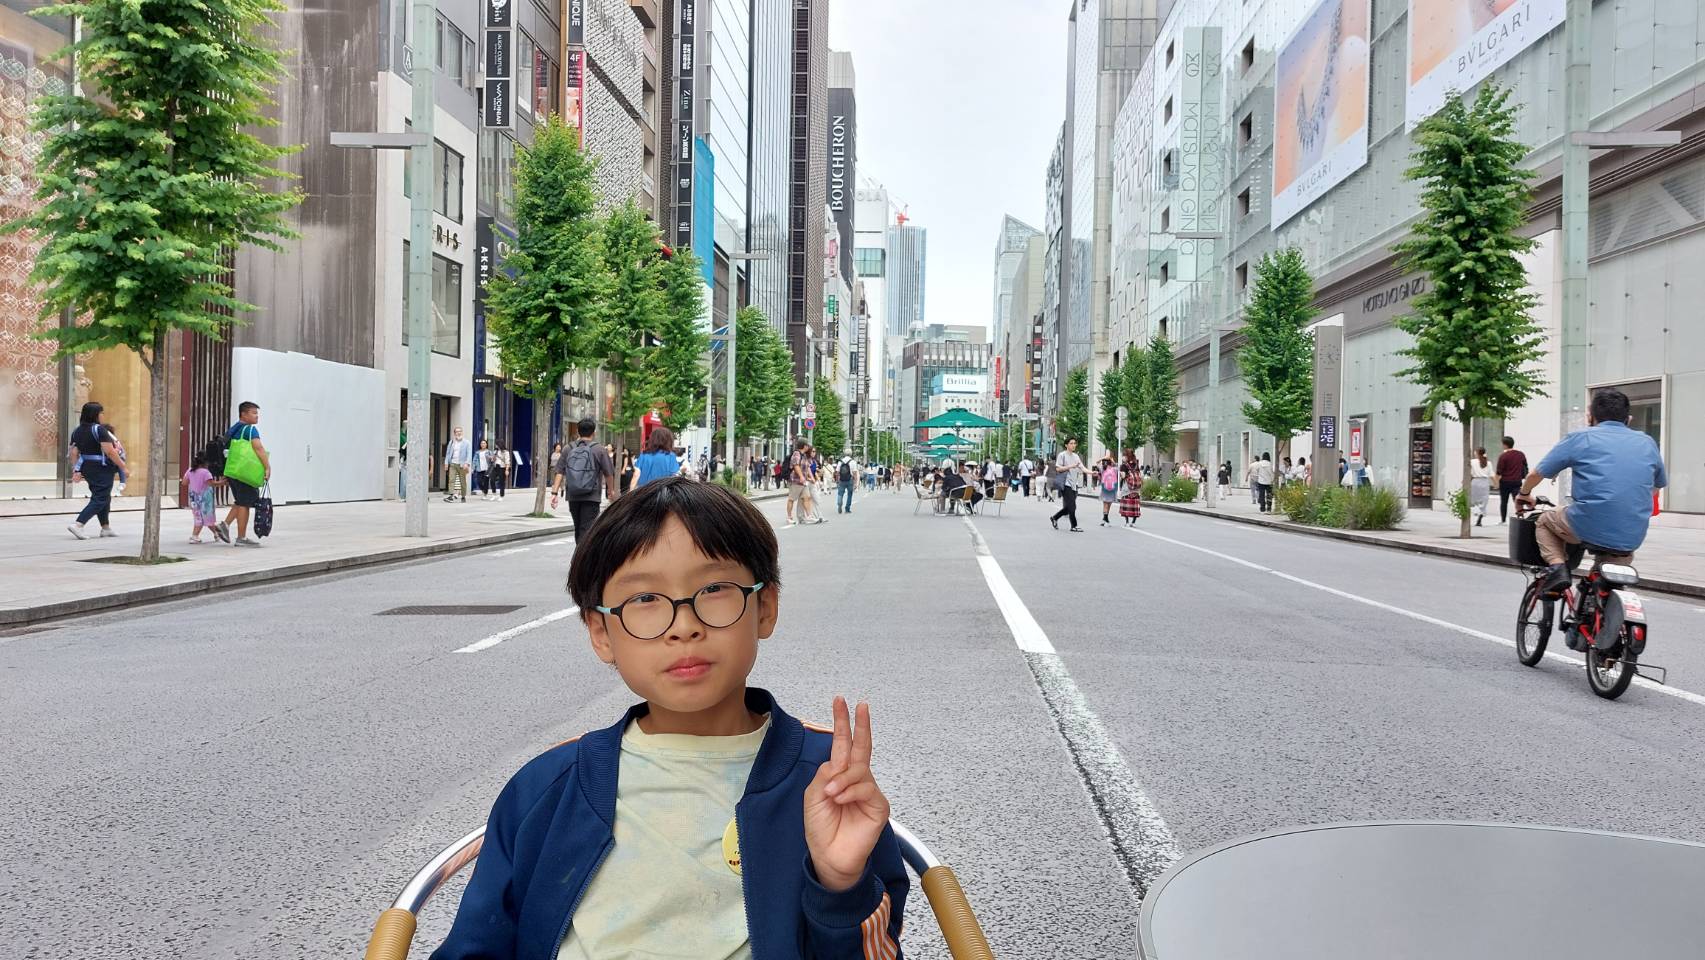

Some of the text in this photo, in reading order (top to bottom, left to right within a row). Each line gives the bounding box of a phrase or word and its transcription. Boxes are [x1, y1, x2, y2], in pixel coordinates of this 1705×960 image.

[570, 53, 581, 62] 4F
[1457, 4, 1530, 73] BVLGARI
[831, 115, 845, 211] BOUCHERON
[1297, 160, 1331, 197] BVLGARI
[1179, 198, 1197, 255] GINA
[946, 377, 977, 385] Brillia
